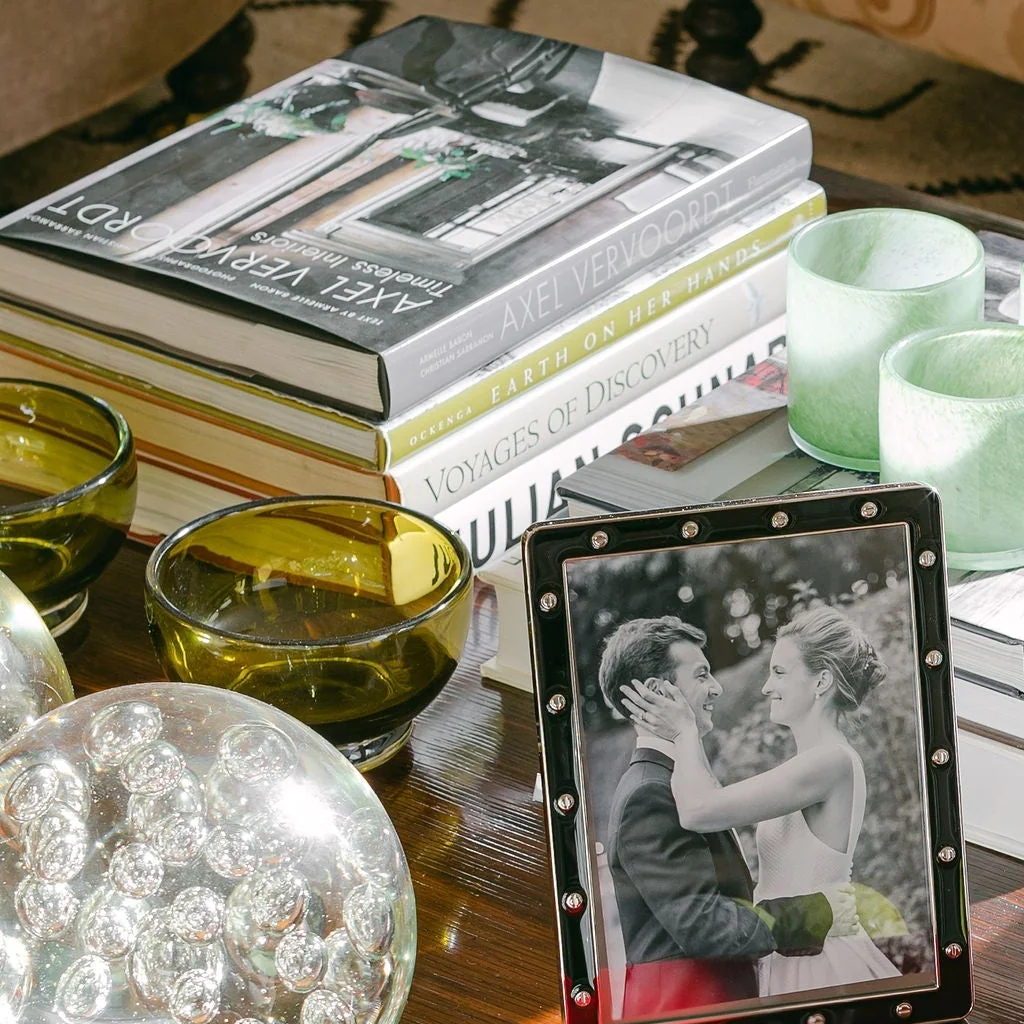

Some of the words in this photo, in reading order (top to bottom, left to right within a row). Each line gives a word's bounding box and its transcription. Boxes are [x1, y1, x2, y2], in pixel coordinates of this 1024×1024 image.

[47, 195, 311, 287] VERVOORDT
[250, 230, 349, 269] Interiors
[351, 260, 453, 298] Timeless
[500, 277, 563, 341] AXEL
[571, 180, 734, 296] VERVOORDT
[320, 275, 434, 315] AXEL
[409, 405, 473, 447] OCKENGA
[490, 346, 569, 405] EARTH
[583, 320, 616, 352] ON
[628, 290, 672, 328] HER
[686, 239, 762, 294] HANDS
[423, 419, 541, 503] VOYAGES
[547, 396, 578, 436] OF
[585, 318, 716, 415] DISCOVERY
